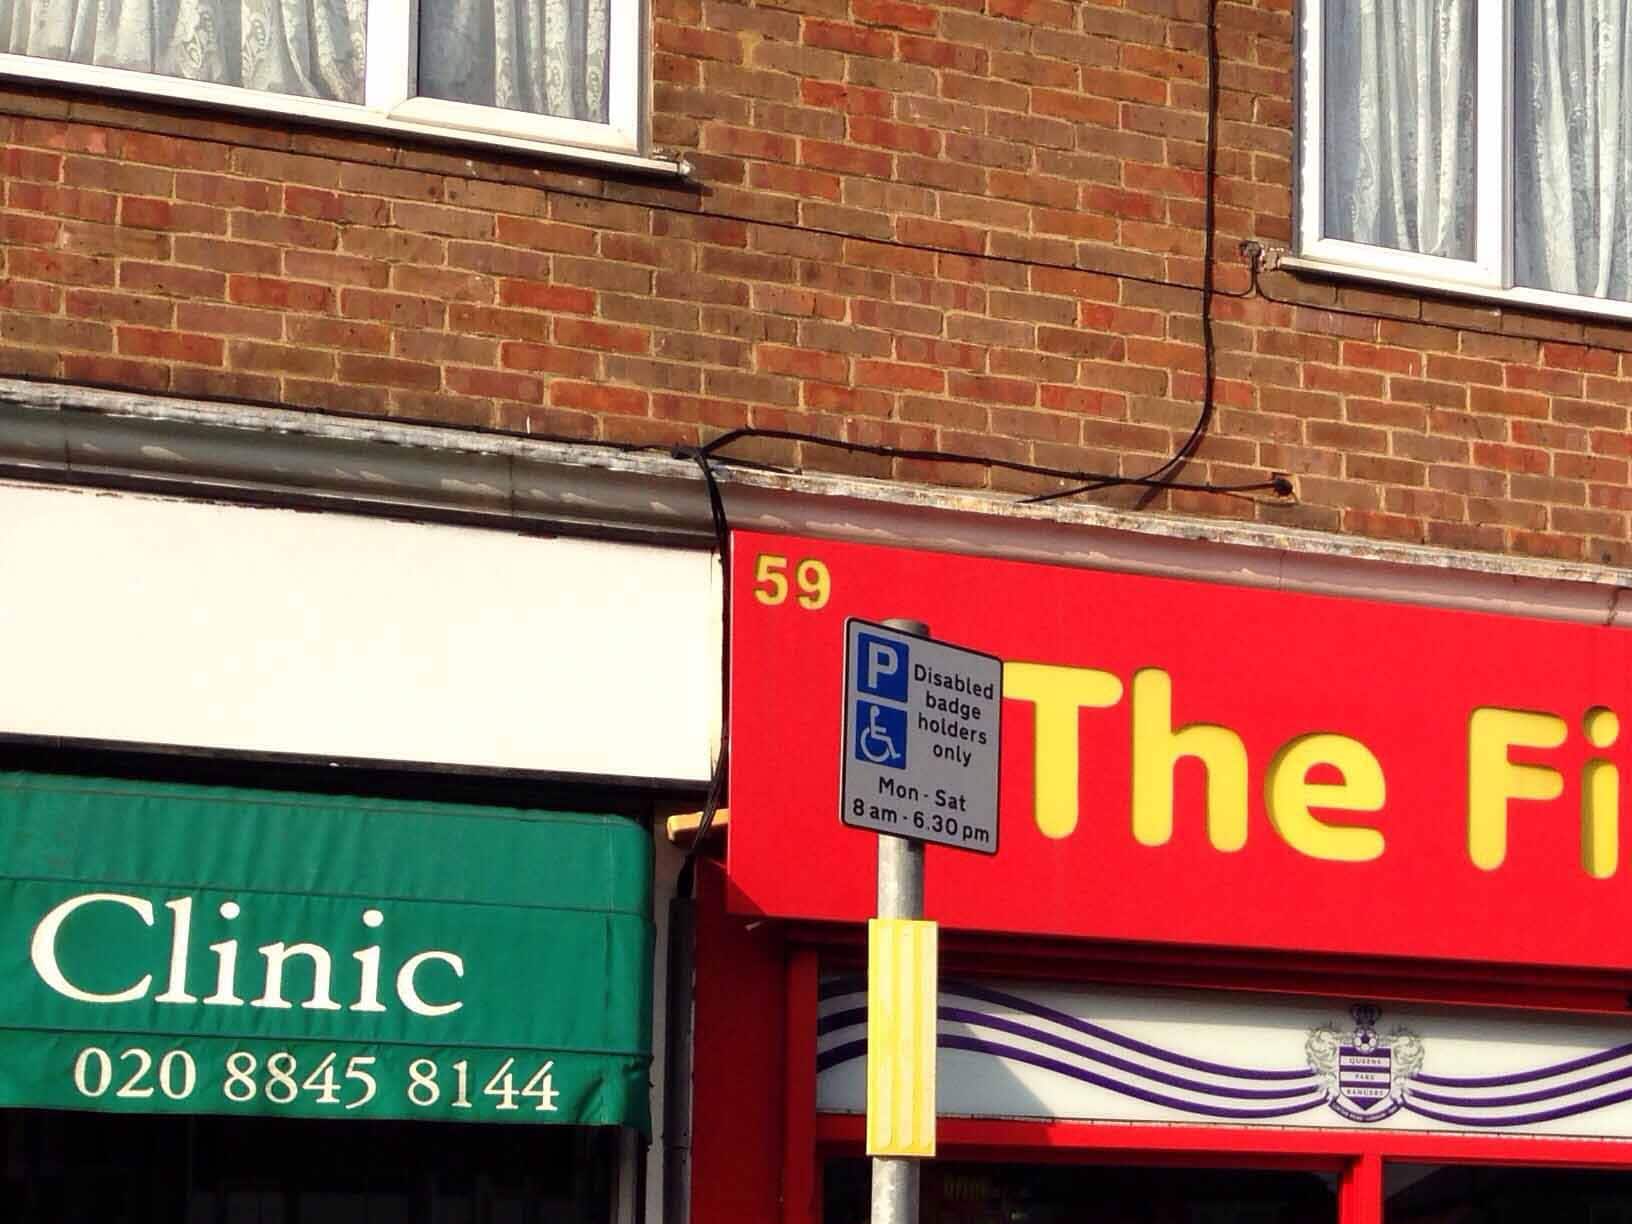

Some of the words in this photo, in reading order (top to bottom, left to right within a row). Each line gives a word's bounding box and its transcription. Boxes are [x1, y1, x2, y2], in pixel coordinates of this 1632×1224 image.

[754, 553, 831, 610] 59
[914, 664, 995, 700] Disabled
[926, 691, 982, 720] badge
[918, 712, 988, 744] holders
[932, 742, 972, 767] only
[1001, 660, 1387, 863] The
[878, 776, 919, 801] Mon
[935, 790, 967, 812] Sat
[853, 798, 864, 816] 8
[869, 808, 897, 824] am
[913, 810, 958, 836] 6.30
[962, 826, 990, 843] pm
[30, 892, 465, 1016] Clinic
[74, 1047, 197, 1100] 020
[223, 1052, 378, 1110] 8845
[407, 1058, 561, 1112] 8144
